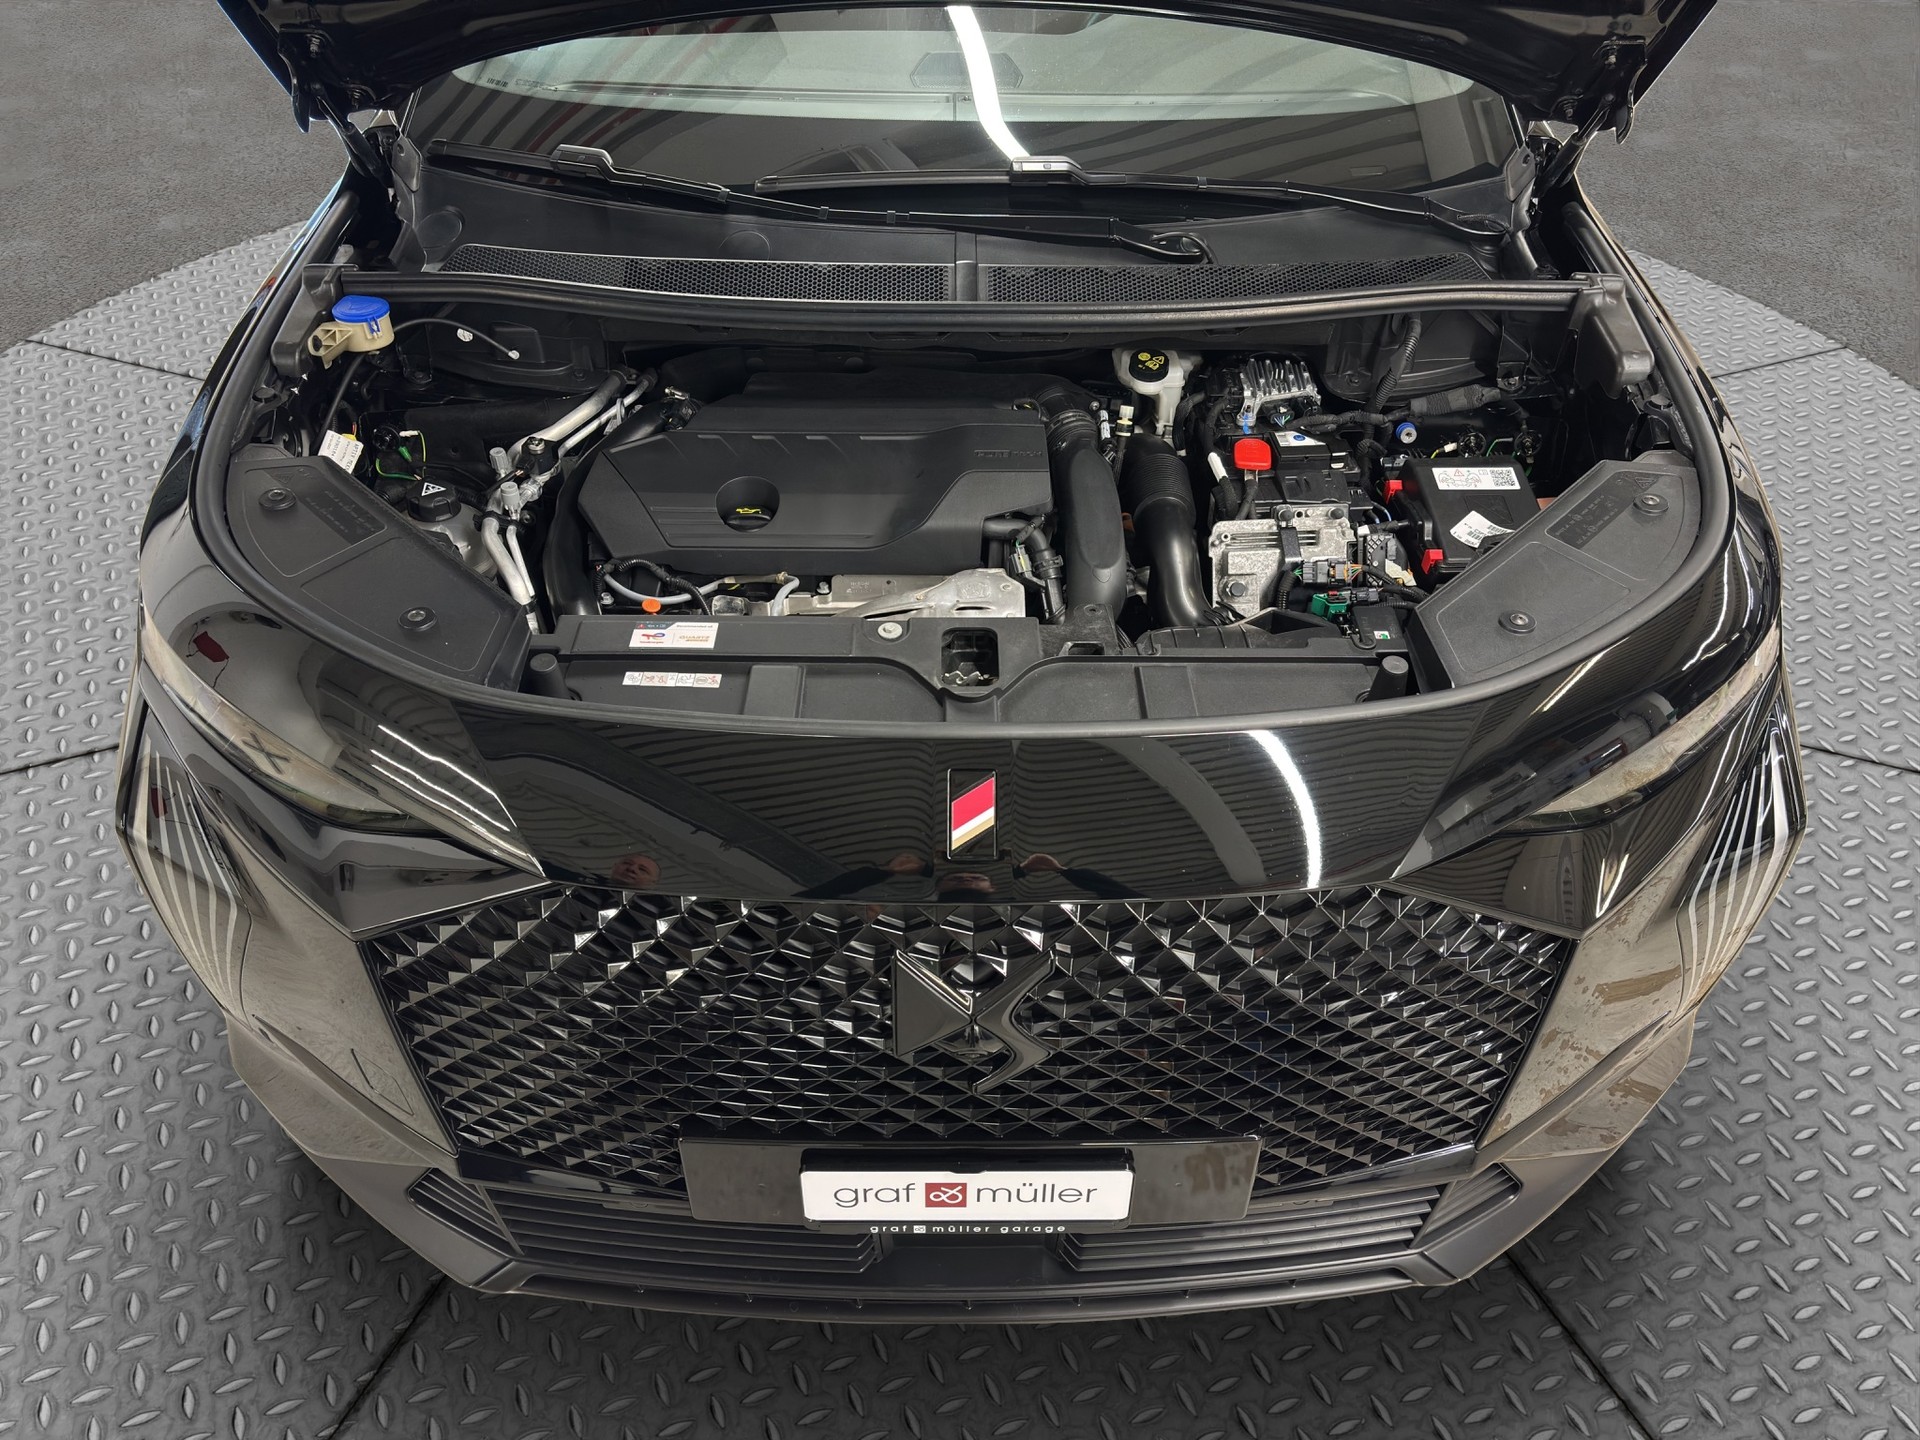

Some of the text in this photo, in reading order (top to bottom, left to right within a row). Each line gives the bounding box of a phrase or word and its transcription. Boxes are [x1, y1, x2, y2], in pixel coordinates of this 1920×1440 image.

[833, 1182, 916, 1208] graf
[976, 1183, 1098, 1203] müller
[870, 1225, 907, 1233] graf
[932, 1225, 990, 1233] müller
[1000, 1225, 1066, 1234] garage
